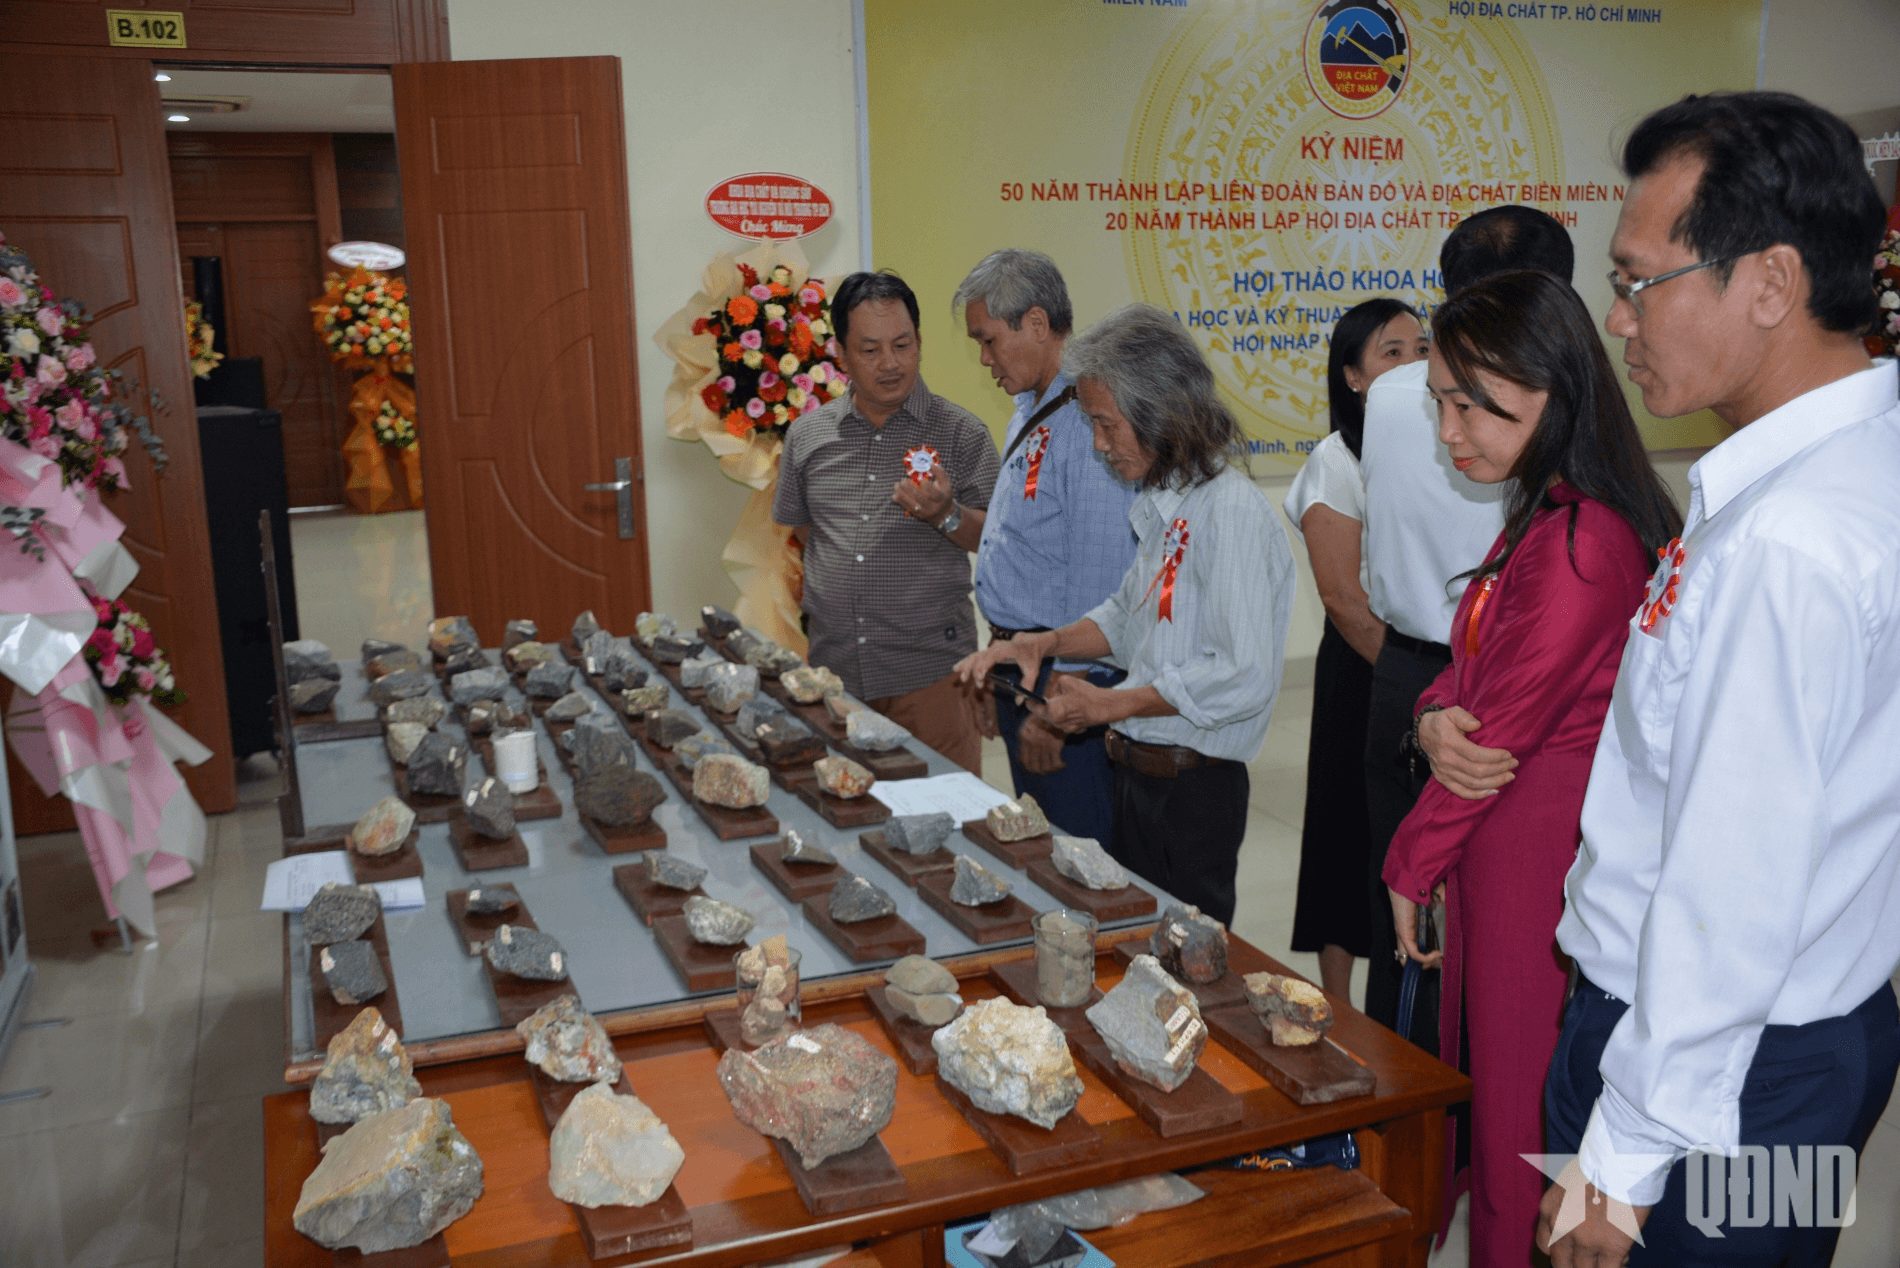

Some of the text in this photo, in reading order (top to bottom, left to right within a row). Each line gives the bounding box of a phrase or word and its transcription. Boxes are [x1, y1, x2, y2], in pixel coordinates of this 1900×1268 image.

[1449, 1, 1661, 23] HỘI ĐỊA CHẤT TP. HỒ CHÍ MINH
[117, 18, 178, 39] B.102
[1357, 84, 1379, 93] NAM
[1301, 131, 1404, 166] KỶ NIỆM
[1001, 183, 1024, 201] 50
[1031, 178, 1079, 201] NĂM
[1085, 178, 1158, 201] THÀNH
[1165, 181, 1205, 206] LẬP
[1211, 179, 1254, 201] LIÊN
[1261, 180, 1317, 201] ĐOÀN
[1324, 180, 1363, 201] BẢN
[1369, 180, 1397, 201] ĐỒ
[1401, 180, 1427, 201] VÀ
[1432, 183, 1463, 206] ĐỊA
[1468, 181, 1516, 201] CHẤT
[1567, 181, 1607, 201] MIỀN
[1105, 212, 1128, 230] 20
[1135, 208, 1181, 230] NĂM
[1187, 208, 1255, 230] THÀNH
[1263, 210, 1300, 234] LẬP
[1306, 211, 1338, 233] HỘI
[1344, 212, 1376, 233] ĐỊA
[1382, 208, 1432, 229] CHẤT
[1234, 269, 1273, 297] HỘI
[1282, 266, 1345, 292] THẢO
[1352, 269, 1415, 290] KHOA
[1188, 309, 1228, 330] HỌC
[1234, 305, 1259, 325] VÀ
[1265, 305, 1289, 325] KỸ
[1233, 334, 1264, 355] HỘI
[1271, 333, 1319, 353] NHẬP
[1248, 439, 1290, 454] Minh,
